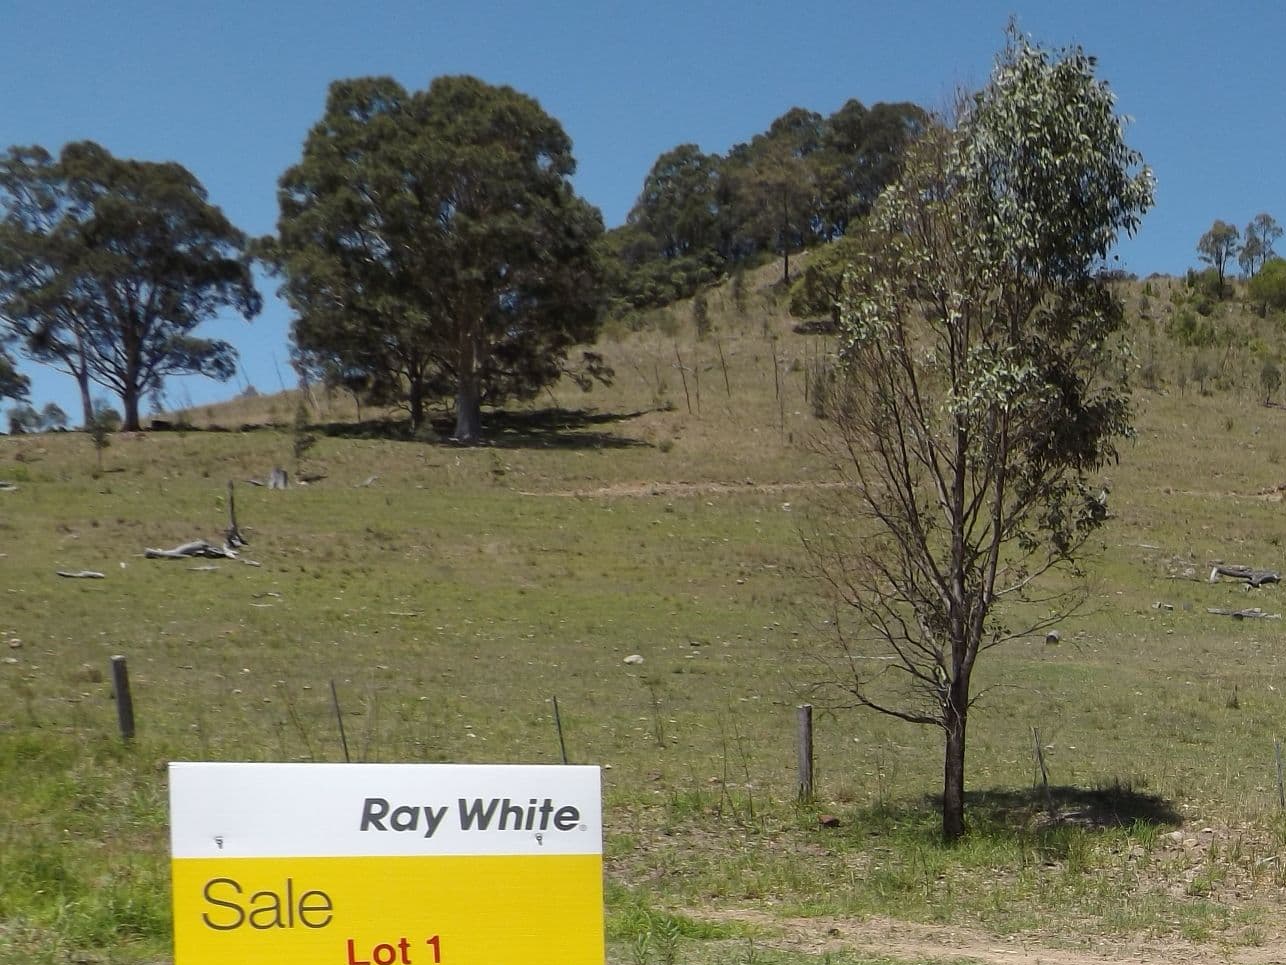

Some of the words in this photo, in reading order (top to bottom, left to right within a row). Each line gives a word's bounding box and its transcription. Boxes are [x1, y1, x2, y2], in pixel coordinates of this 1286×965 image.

[360, 798, 447, 838] Ray
[458, 798, 581, 831] White
[202, 877, 333, 931] Sale
[427, 935, 442, 965] 1
